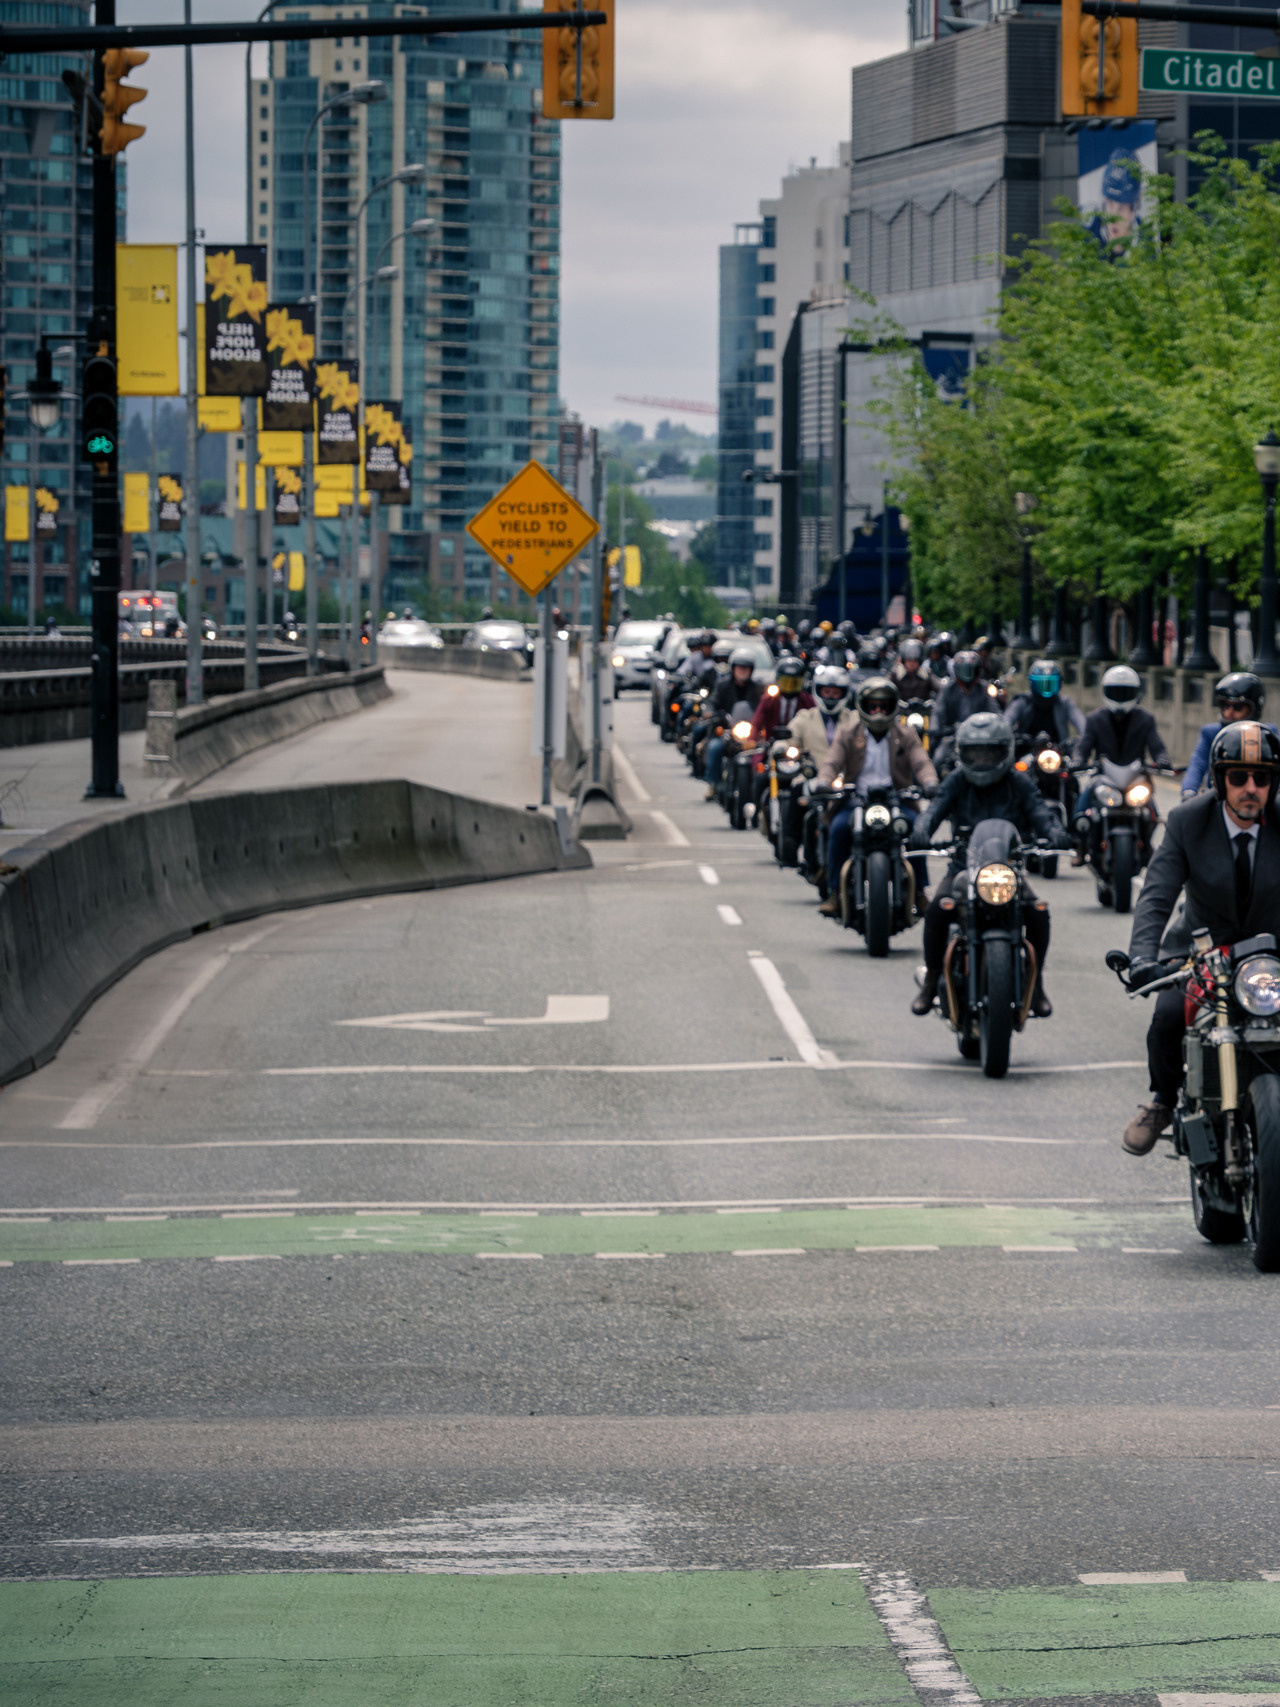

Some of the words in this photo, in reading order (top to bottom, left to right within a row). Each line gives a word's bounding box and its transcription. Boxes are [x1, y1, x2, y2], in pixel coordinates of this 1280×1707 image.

[1163, 56, 1275, 90] Citadel
[497, 502, 568, 515] CYCLISTS
[500, 520, 541, 533] YIELD
[548, 520, 567, 533] TO
[491, 538, 574, 549] PEDESTRIANS
